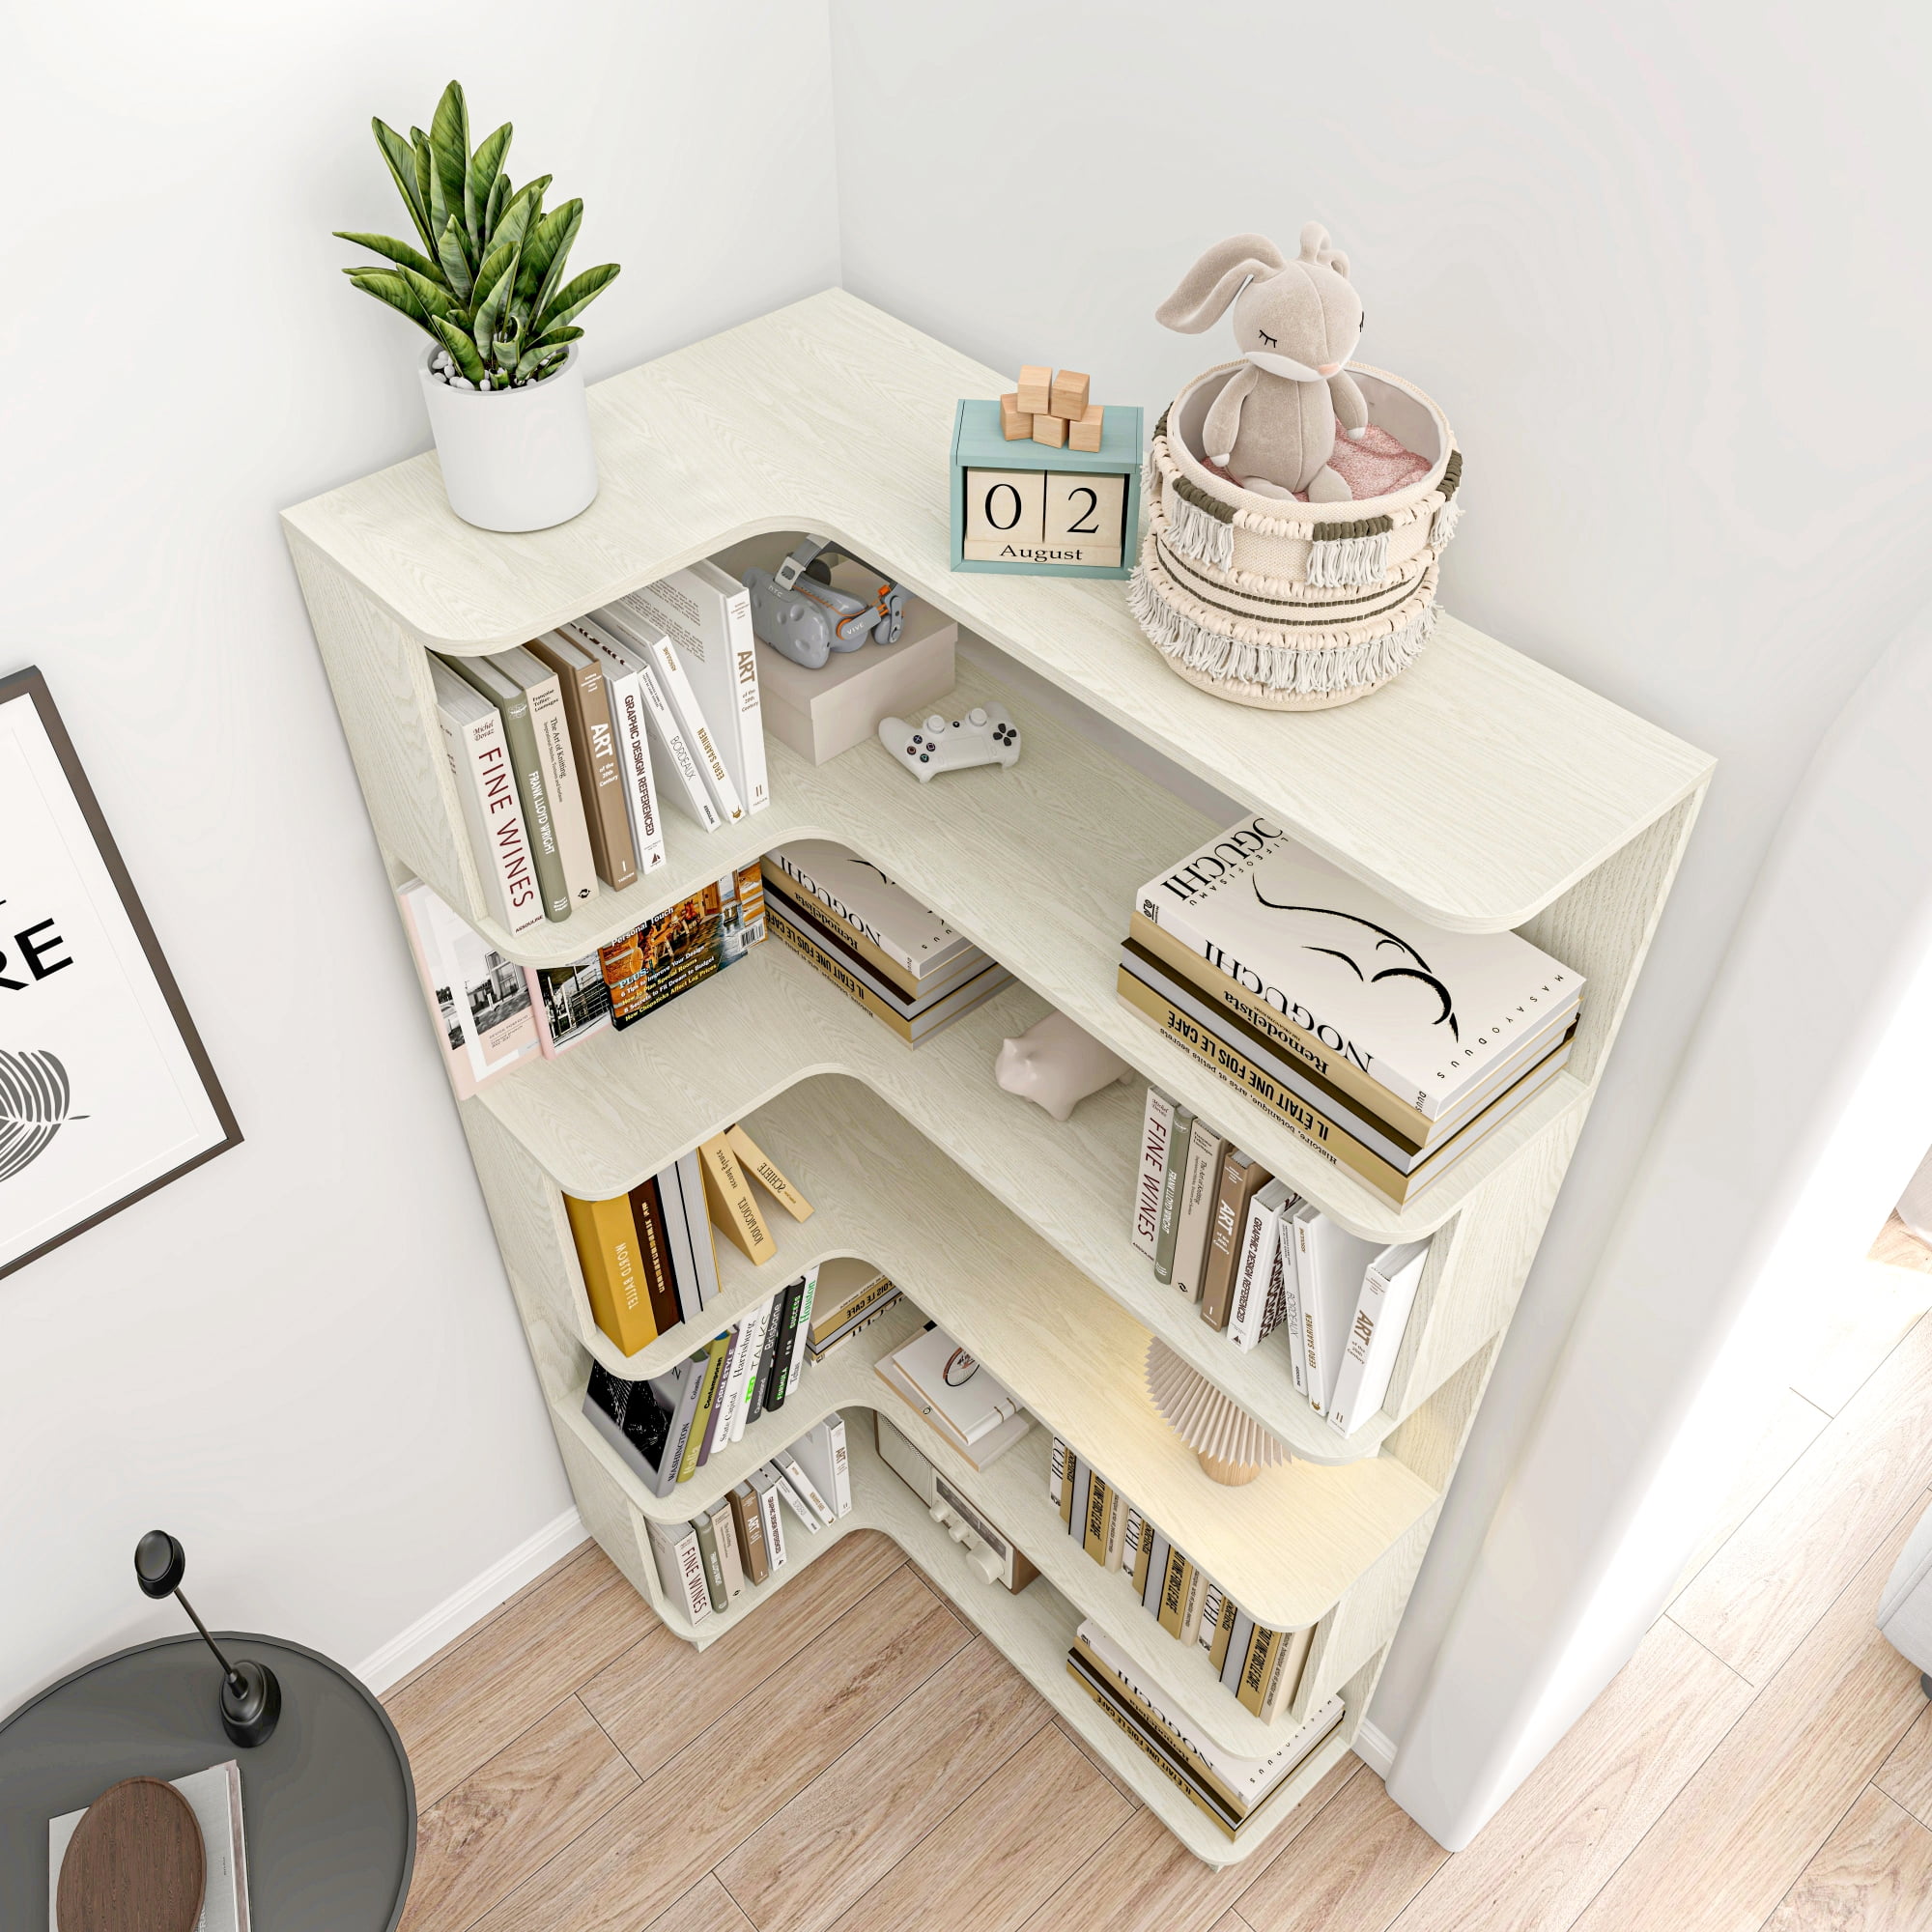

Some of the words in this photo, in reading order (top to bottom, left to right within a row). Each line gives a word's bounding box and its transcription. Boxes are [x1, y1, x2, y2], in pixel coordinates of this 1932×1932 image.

[985, 483, 1022, 530] 0
[1066, 487, 1099, 533] 2
[999, 545, 1083, 562] August
[846, 621, 866, 636] VIVE
[738, 651, 755, 684] ART
[472, 719, 495, 735] Michel
[625, 695, 639, 740] GRAPHIC
[591, 723, 612, 758] ART
[697, 727, 717, 763] SAARINEN
[557, 752, 566, 779] Knitting
[632, 740, 645, 777] DESIGN
[670, 736, 696, 781] BORDEAUX
[713, 761, 724, 781] EERO
[528, 771, 543, 799] FRANK
[599, 775, 618, 787] Century
[535, 798, 549, 824] LLOYD
[638, 777, 655, 837] REFERENCED
[479, 747, 513, 814] FINE
[497, 817, 534, 908] WINES
[541, 822, 554, 855] WRIGHT
[1160, 817, 1283, 900] OGUCHI
[781, 855, 882, 950] NOGUCHI
[611, 921, 647, 947] Personal
[651, 906, 674, 925] Touch
[786, 927, 796, 943] LE
[794, 891, 859, 952] Remodelista
[647, 966, 670, 981] Improve
[672, 957, 684, 966] Your
[686, 945, 705, 959] Design
[798, 937, 814, 958] FOIS
[815, 951, 833, 972] UNE
[619, 967, 649, 989] PLUS:
[622, 995, 636, 1005] How
[657, 970, 677, 985] Special
[678, 958, 697, 972] Rooms
[626, 1010, 638, 1021] How
[639, 993, 669, 1013] Chopsticks
[670, 980, 688, 995] Affect
[699, 964, 717, 977] Prices
[630, 995, 651, 1009] Secrets
[668, 974, 687, 987] Dream
[696, 956, 715, 971] Budget
[834, 966, 855, 993] ÉTAIT
[856, 985, 865, 1000] IL
[1206, 939, 1375, 1075] NOGUCHI
[1492, 974, 1564, 1035] MASAYO
[1159, 1028, 1190, 1054] secrets
[1167, 1009, 1199, 1043] CAFÉ
[1224, 990, 1329, 1076] Remodelista
[1200, 1035, 1215, 1053] LE
[1437, 1037, 1488, 1079] DUUS
[1192, 1051, 1217, 1074] petits
[1218, 1049, 1246, 1080] FOIS
[1219, 1071, 1228, 1082] et
[1229, 1080, 1248, 1097] arts
[1248, 1070, 1275, 1097] UNE
[1250, 1094, 1296, 1133] botanique,
[1276, 1094, 1314, 1130] ÉTAIT
[1146, 1117, 1167, 1173] FINE
[1318, 1119, 1329, 1141] IL
[1298, 1130, 1338, 1165] Histoire,
[1138, 1174, 1161, 1242] WINES
[1217, 1200, 1235, 1236] ART
[1250, 1217, 1262, 1252] GRAPHIC
[1244, 1250, 1256, 1279] DESIGN
[799, 1280, 815, 1323] Houston
[1236, 1277, 1251, 1323] REFERENCED
[1287, 1291, 1298, 1339] BORDEAUX
[765, 1303, 781, 1350] Brisbane
[1304, 1312, 1315, 1350] SAARINEN
[1353, 1310, 1374, 1347] ART
[733, 1321, 755, 1379] Harrisburg
[777, 1366, 788, 1401] FORMULA
[788, 1294, 802, 1329] SUCCESS
[715, 1380, 726, 1408] FORM
[724, 1349, 734, 1380] STYLE
[745, 1376, 755, 1404] TED
[724, 1392, 737, 1421] Capital
[720, 1422, 729, 1441] State
[668, 1422, 690, 1482] WASHINGTON
[748, 1515, 759, 1534] ART
[682, 1547, 699, 1577] FINE
[688, 1574, 707, 1613] WINES
[1251, 1650, 1264, 1670] FOIS
[1254, 1638, 1268, 1659] UNE
[1249, 1662, 1262, 1678] LE
[1117, 1718, 1126, 1728] LE
[1126, 1726, 1144, 1747] FOIS
[1146, 1745, 1160, 1763] UNE
[1184, 1783, 1191, 1795] IL
